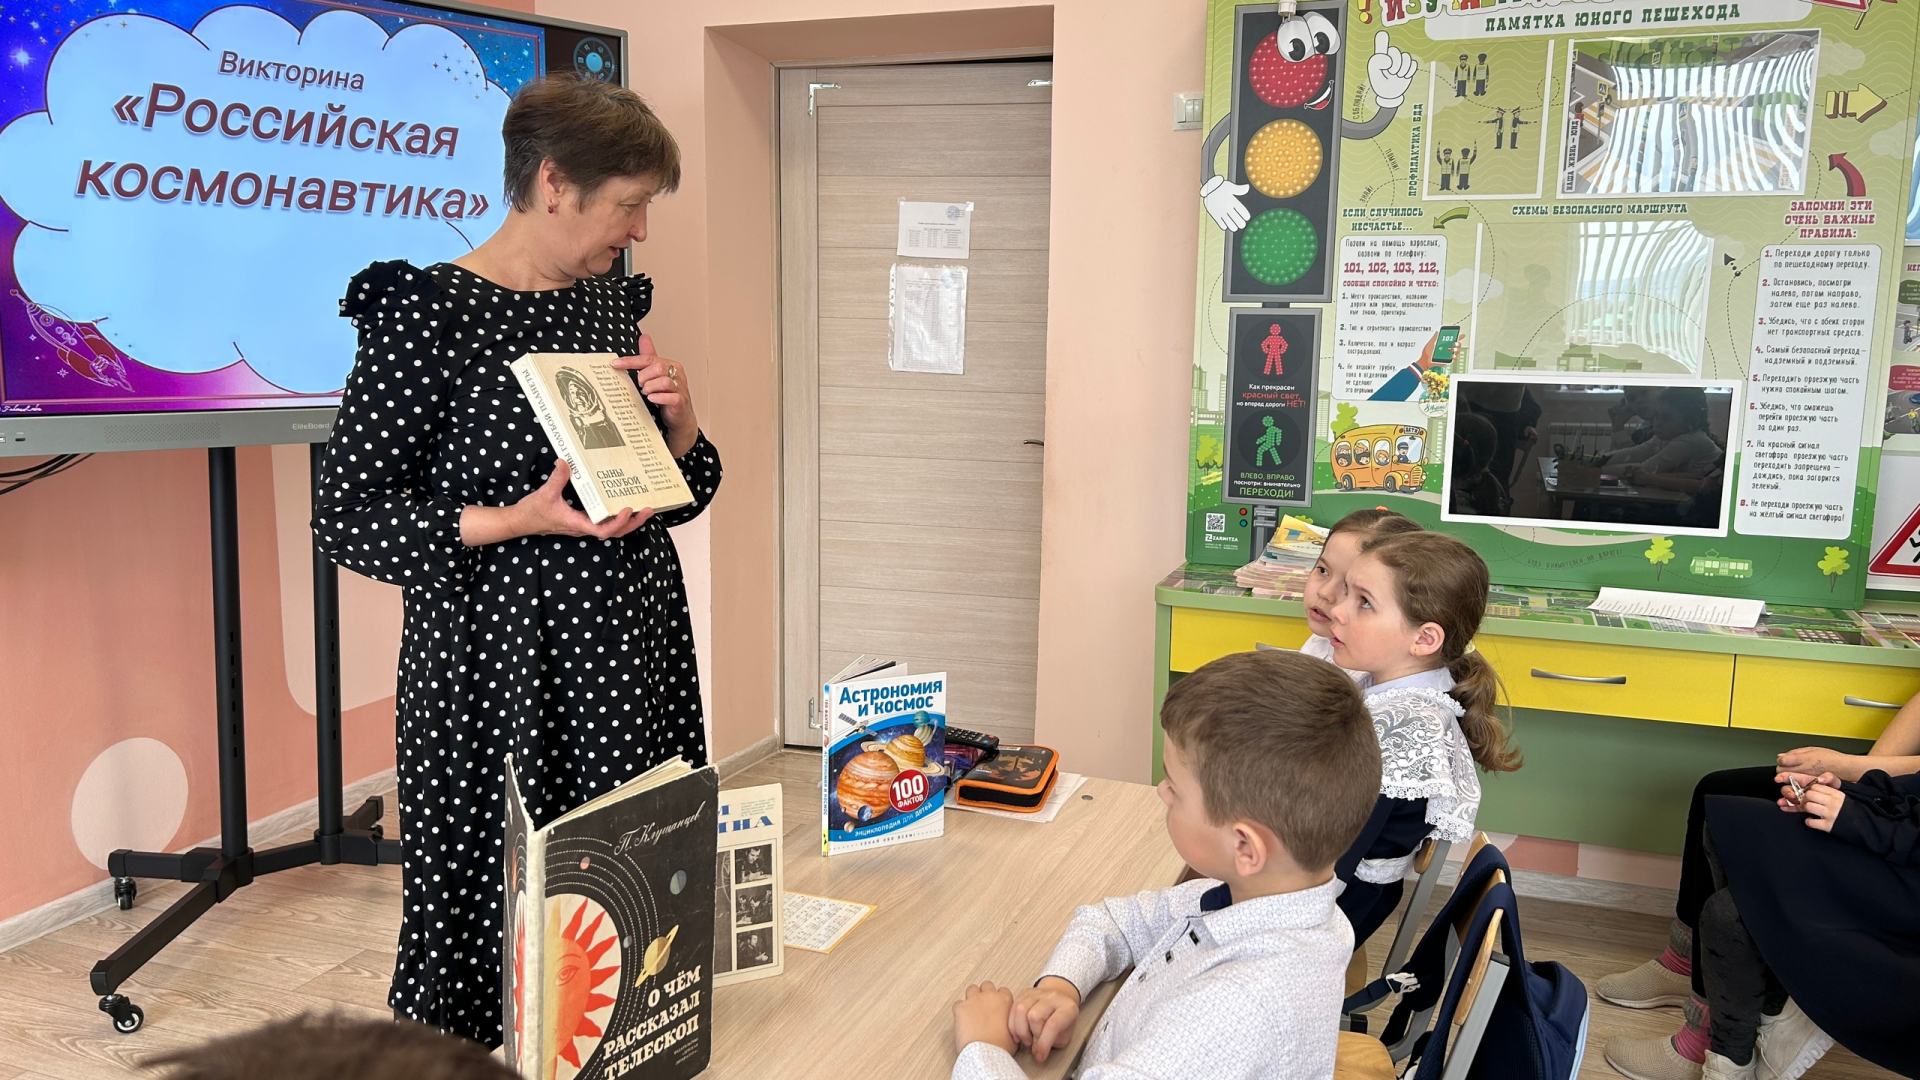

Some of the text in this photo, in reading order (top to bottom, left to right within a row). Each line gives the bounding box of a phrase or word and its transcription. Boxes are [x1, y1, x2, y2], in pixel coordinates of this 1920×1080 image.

[1485, 4, 1740, 32] ПАМЯТКА ЮНОГО ПЕШЕХОДА
[219, 51, 365, 91] Викторина
[113, 83, 458, 157] «Российская
[1408, 104, 1423, 196] ПРОФИЛАКТИКА БДД
[1385, 148, 1400, 171] ПОМНИ!
[1568, 145, 1576, 167] ЖИЗНЬ
[1566, 171, 1574, 190] НАША
[76, 159, 489, 219] космонавтика»
[1359, 185, 1374, 203] ЗНАЙ!
[1512, 204, 1687, 215] СХЕМЫ БЕЗОПАСНОГО МАРШРУТА
[1791, 200, 1872, 211] ЗАПОМНИ ЭТИ
[1343, 208, 1423, 217] ЕСЛИ СЛУЧИЛОСЬ
[1785, 214, 1875, 225] ОЧЕНЬ ВАЖНЫЕ
[1352, 222, 1412, 231] НЕСЧАСТЬЕ...
[1800, 229, 1856, 238] ПРАВИЛА:
[1346, 239, 1365, 247] Позови
[1410, 240, 1440, 248] взрослых,
[1396, 249, 1426, 259] телефону:
[1775, 249, 1811, 258] Переходи
[1814, 250, 1840, 258] дорогу
[1344, 262, 1439, 275] 101, 102, 103, 112,
[1785, 261, 1833, 269] пешеходному
[1836, 261, 1869, 269] переходу.
[1774, 278, 1815, 287] Остановись,
[1818, 280, 1851, 288] посмотри
[1771, 290, 1799, 298] налево,
[1828, 290, 1861, 299] направо,
[1814, 301, 1827, 309] раз
[1831, 301, 1860, 309] налево.
[1769, 317, 1797, 326] Убедись,
[1821, 317, 1839, 325] обеих
[1842, 318, 1865, 327] сторон
[1782, 329, 1830, 337] транспортных
[1833, 329, 1864, 338] средств.
[1767, 345, 1789, 353] Самый
[1792, 346, 1830, 354] безопасный
[1833, 347, 1860, 356] переход
[1765, 357, 1805, 365] надземный
[1815, 357, 1857, 366] подземный.
[1763, 374, 1801, 383] Переходить
[1804, 376, 1837, 385] проезжую
[522, 369, 547, 413] ПЛАНЕТЫ
[1762, 386, 1782, 394] нужно
[1786, 386, 1821, 394] спокойным
[1242, 392, 1278, 400] красный
[1287, 400, 1306, 408] НЕТ!
[1760, 402, 1787, 411] Убедись,
[1759, 413, 1782, 422] перейти
[1785, 414, 1816, 423] проезжую
[545, 413, 568, 452] ГОЛУБОЙ
[1788, 425, 1801, 433] раз.
[1747, 440, 1753, 448] 7.
[1768, 441, 1795, 449] красный
[1755, 451, 1788, 460] светофора
[1794, 453, 1826, 462] проезжую
[1754, 462, 1830, 472] переходить запрещено
[597, 468, 625, 479] СЫНЫ
[1240, 472, 1265, 480] ВЛЕВО,
[1753, 472, 1785, 480] дождись,
[601, 475, 641, 489] ГОЛУБОЙ
[1752, 482, 1781, 490] зеленый.
[605, 485, 649, 498] ПЛАНЕТЫ
[1239, 487, 1294, 498] ПЕРЕХОДИ!
[1740, 499, 1748, 507] 8.
[1761, 501, 1789, 509] переходи
[1792, 502, 1822, 511] проезжую
[1809, 513, 1844, 523] светофора!
[1527, 559, 1542, 567] БУДЬ
[839, 680, 943, 706] Астрономия
[857, 695, 934, 717] и космос
[892, 774, 924, 800] 100
[897, 794, 924, 808] ФАКТОВ
[854, 801, 933, 837] энциклопедия для детей
[647, 965, 701, 1007] О ЧЁМ
[603, 990, 700, 1060] РАССКАЗАЛ
[604, 1014, 699, 1080] ТЕЛЕСКОП
